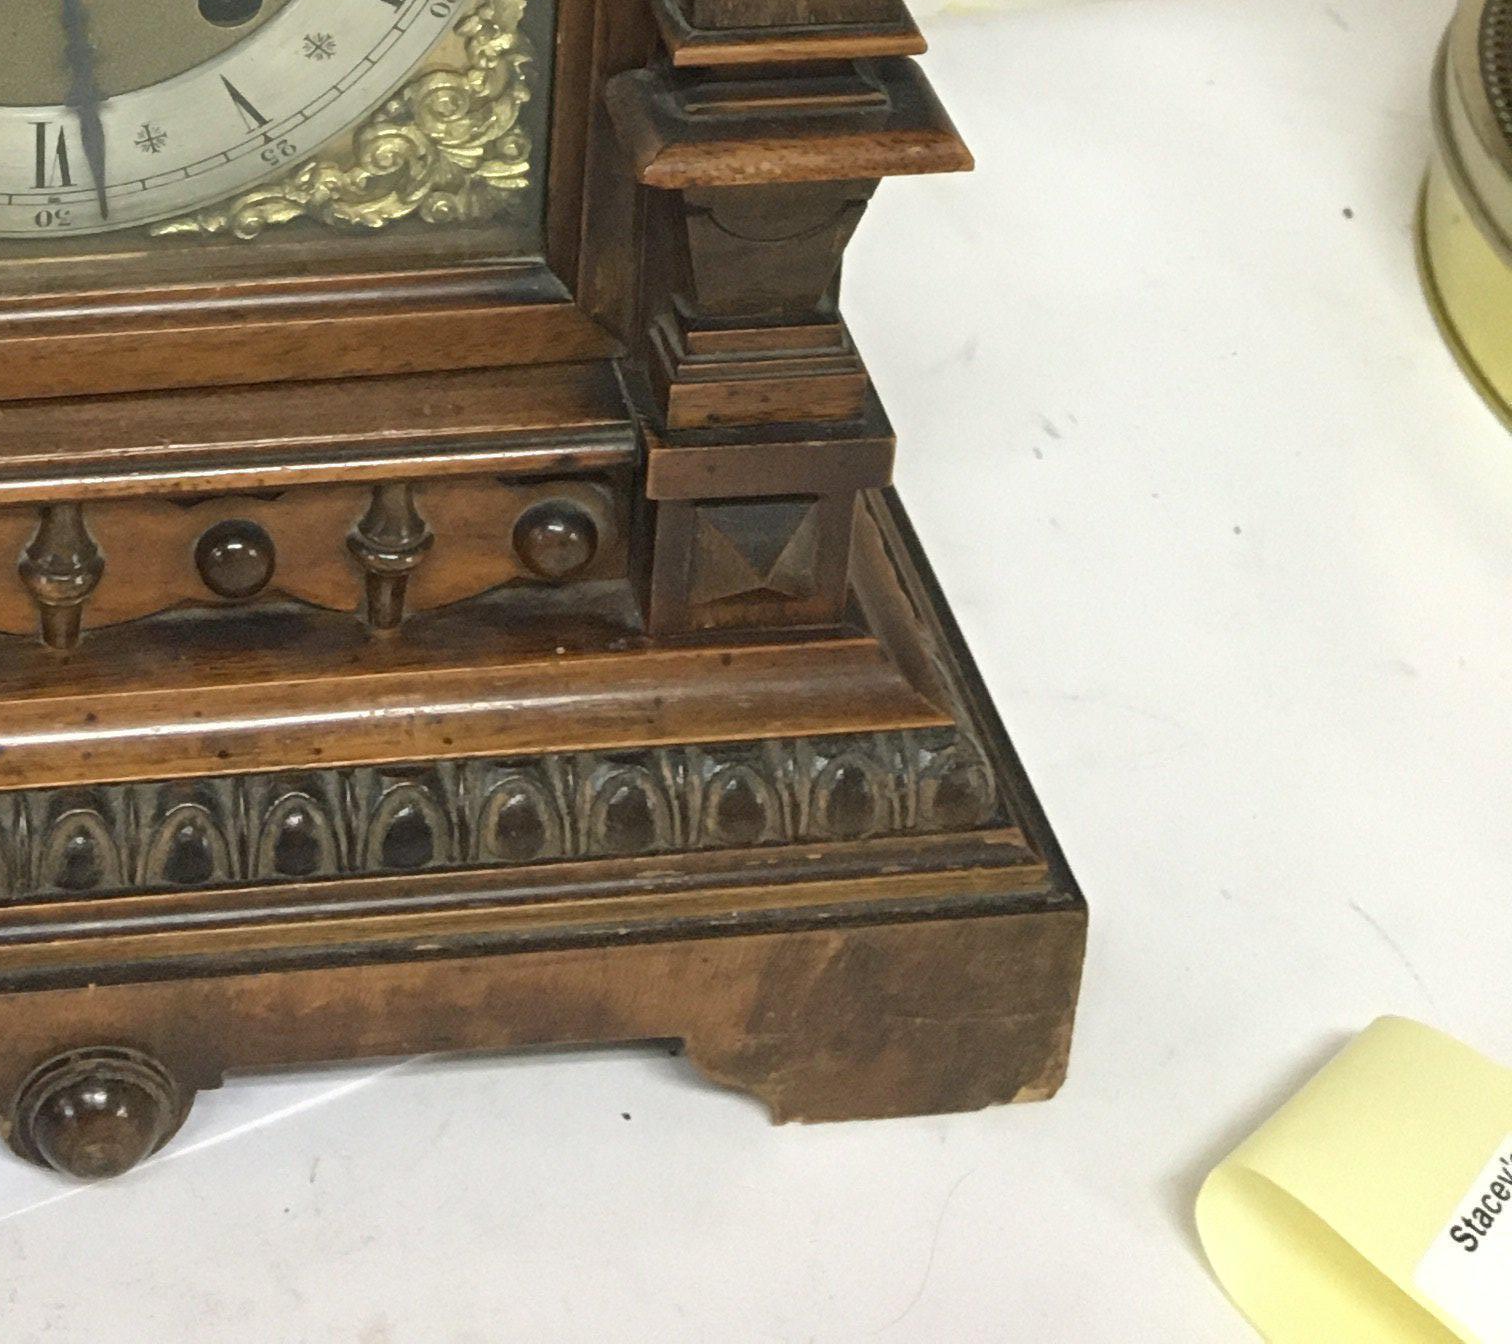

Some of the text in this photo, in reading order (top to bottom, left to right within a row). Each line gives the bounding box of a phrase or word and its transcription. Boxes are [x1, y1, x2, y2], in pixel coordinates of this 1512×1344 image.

[220, 73, 273, 134] V
[28, 121, 78, 190] VI
[259, 138, 298, 167] 25
[34, 208, 73, 227] 30
[1449, 1153, 1512, 1252] Stacey'
